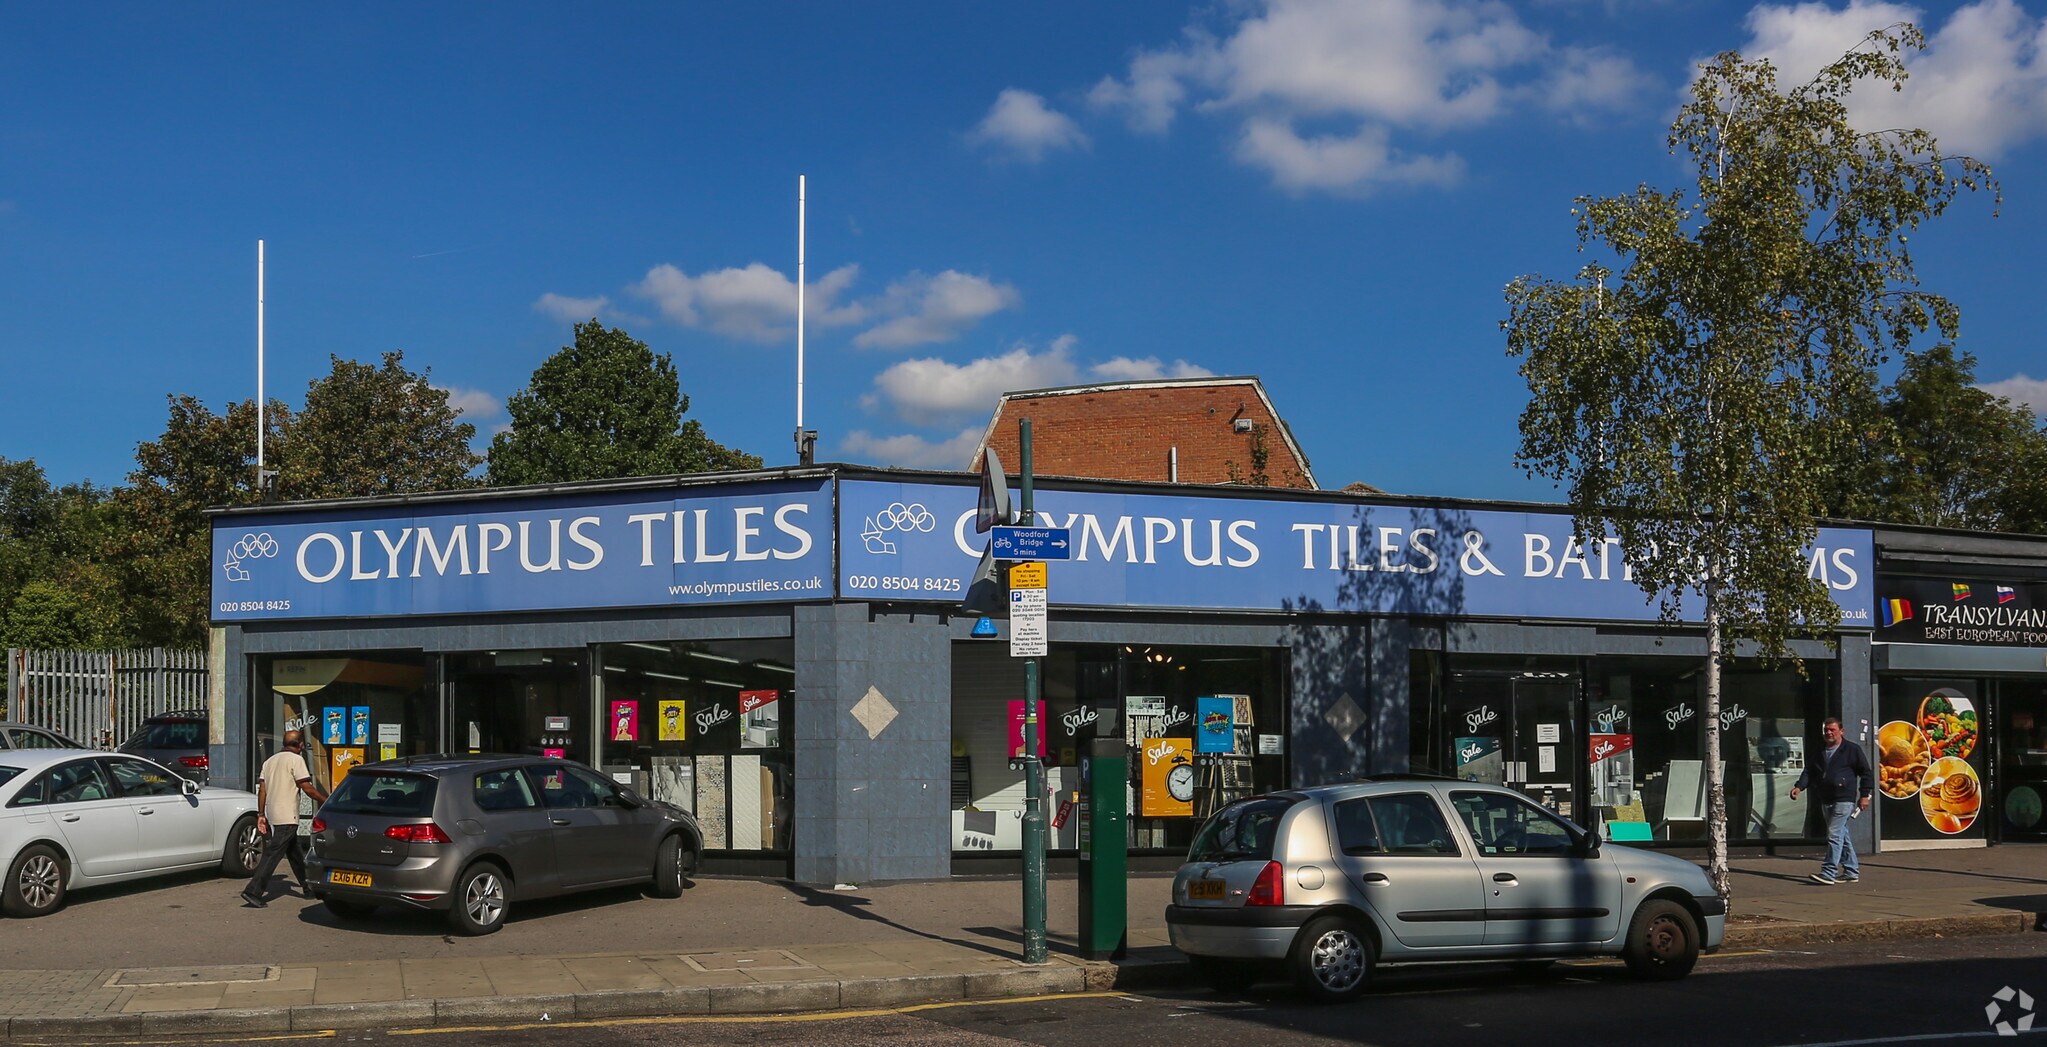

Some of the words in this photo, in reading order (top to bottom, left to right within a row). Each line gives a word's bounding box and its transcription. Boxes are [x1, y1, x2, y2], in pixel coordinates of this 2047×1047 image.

[296, 516, 604, 583] OLYMPUS
[628, 503, 813, 567] TILES
[954, 508, 1260, 568] OYMPUS
[1292, 524, 1439, 574] TILES
[1460, 530, 1505, 576] &
[1013, 530, 1049, 539] Woodford
[1020, 538, 1044, 547] Bridge
[1013, 548, 1019, 556] 5
[849, 576, 878, 591] 020
[882, 576, 919, 592] 8504
[924, 577, 960, 593] 8425
[221, 602, 238, 612] 020
[241, 601, 264, 611] 8504
[266, 600, 291, 611] 8425
[1013, 592, 1020, 601] P
[1923, 603, 2047, 628] TRANSYLVAN
[1925, 626, 1954, 640] EAST
[1956, 628, 2020, 642] EUROPEAN
[743, 695, 761, 712] Sale
[696, 703, 732, 735] Sale
[1063, 705, 1099, 736] Sale
[1466, 705, 1498, 733] Sale
[1598, 704, 1627, 732] Sale
[1665, 702, 1695, 730] Sale
[1720, 703, 1748, 730] Sale
[336, 749, 353, 766] Sale
[1147, 741, 1176, 765] Sale
[1461, 743, 1483, 763] Sale
[1593, 740, 1615, 760] Sale
[333, 871, 351, 883] EX16
[352, 873, 370, 885] KZR
